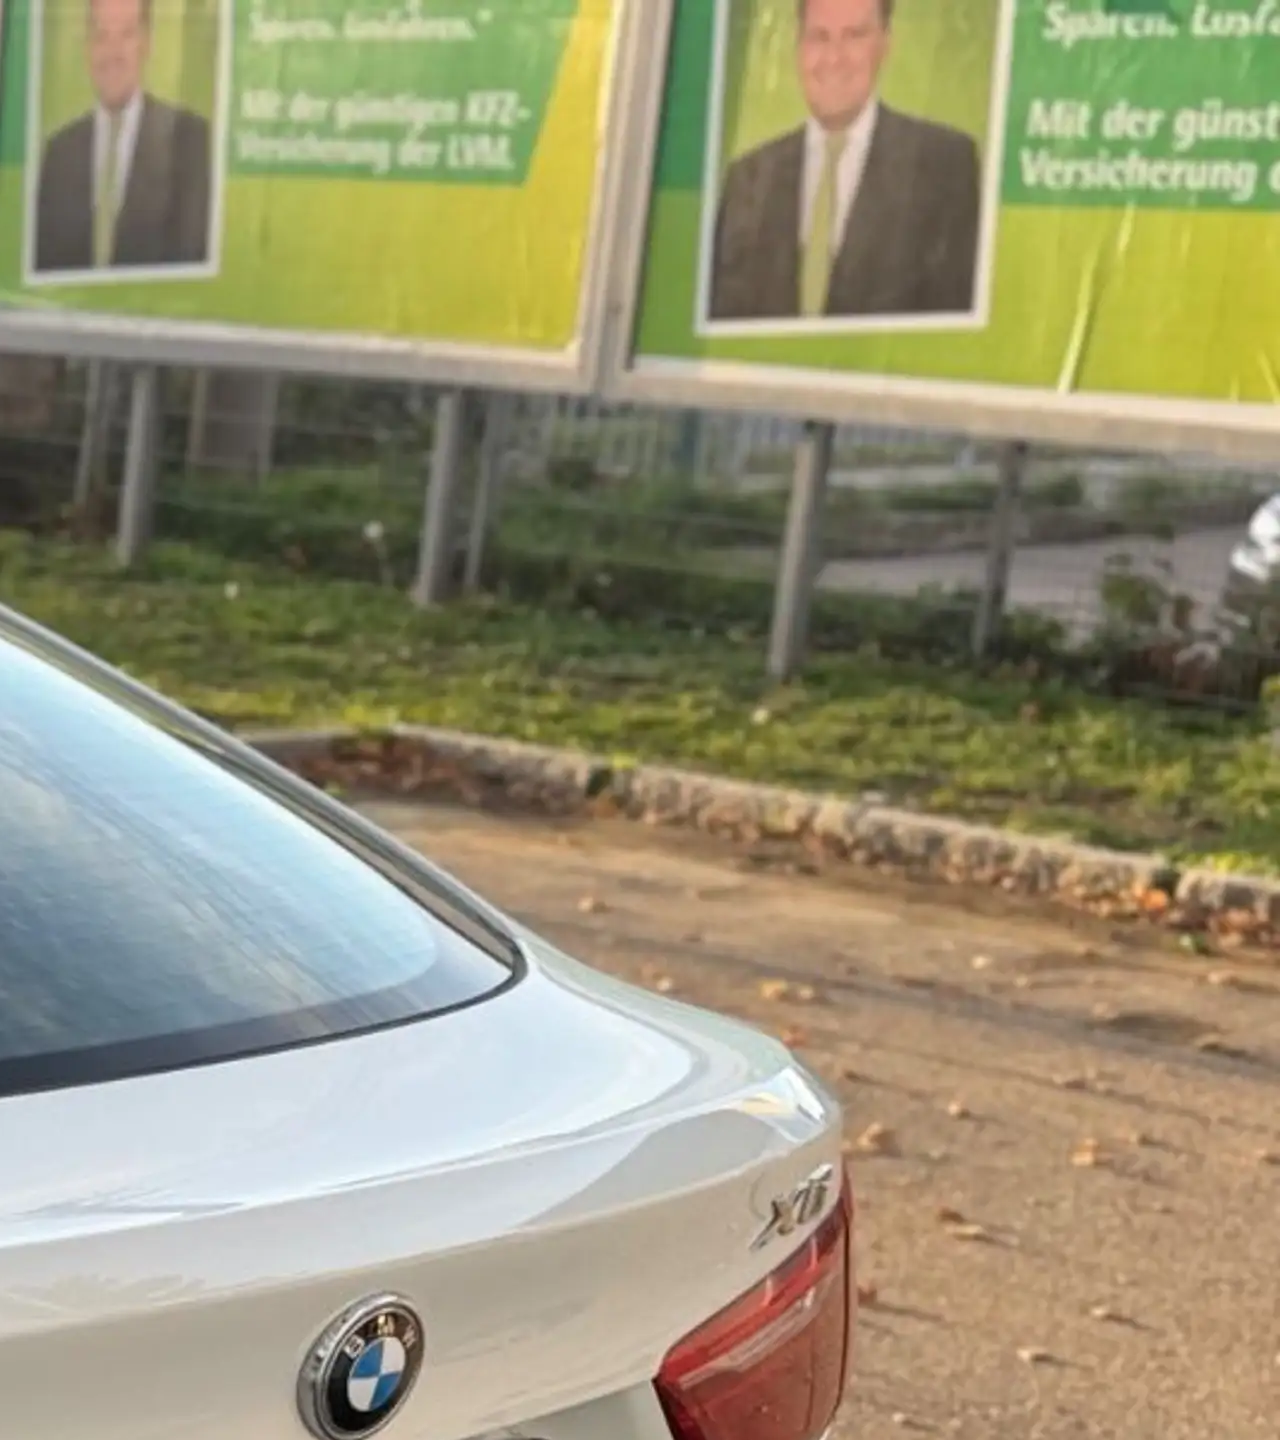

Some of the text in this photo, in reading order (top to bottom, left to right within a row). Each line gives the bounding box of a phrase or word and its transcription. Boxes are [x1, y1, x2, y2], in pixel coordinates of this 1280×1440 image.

[1026, 98, 1092, 139] Mit
[1101, 98, 1165, 140] der
[1019, 147, 1258, 204] Versicherung
